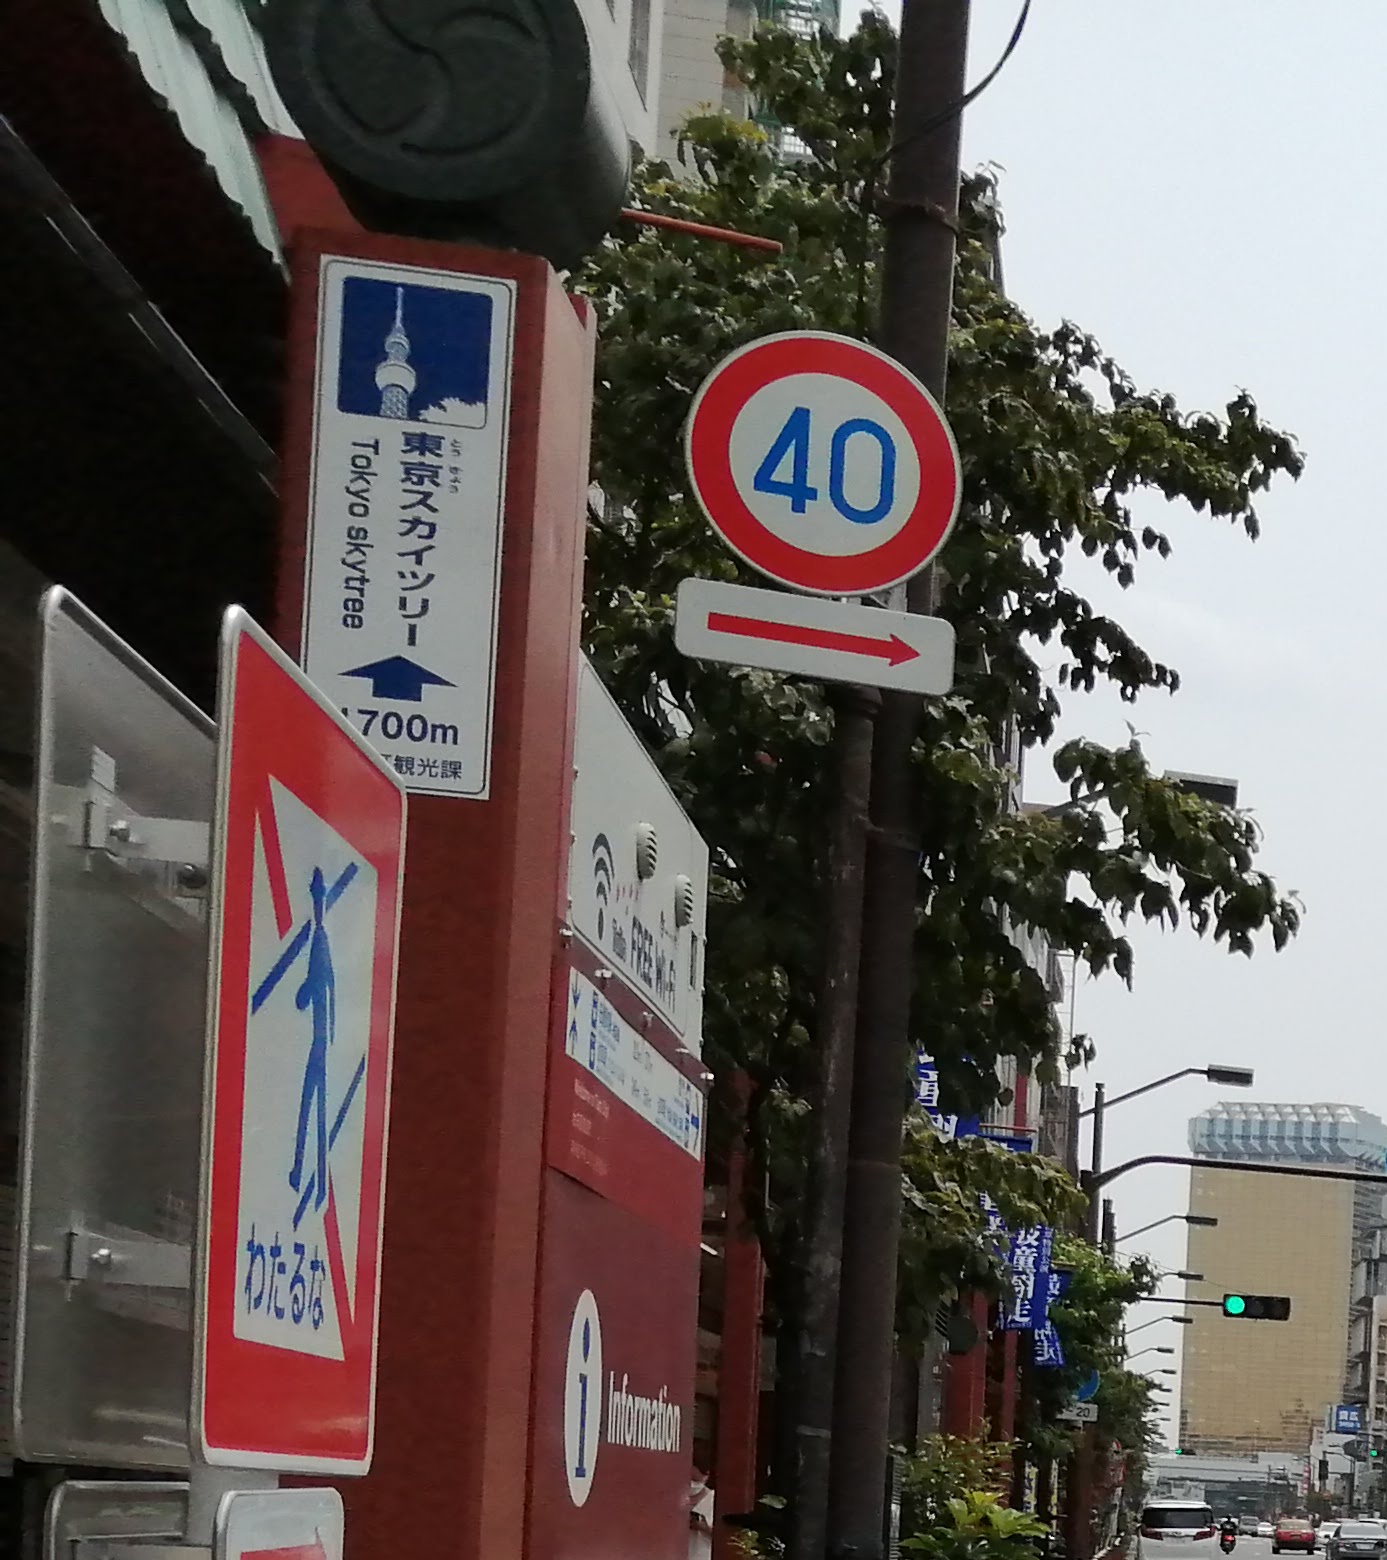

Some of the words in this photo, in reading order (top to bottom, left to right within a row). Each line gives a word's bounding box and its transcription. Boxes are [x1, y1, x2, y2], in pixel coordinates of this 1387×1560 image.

[345, 438, 380, 518] Tokyo
[752, 406, 895, 525] 40
[341, 525, 375, 629] skytree
[397, 431, 446, 647] 東京スカイツリー
[245, 1222, 326, 1331] わたるな
[607, 1370, 682, 1453] Information
